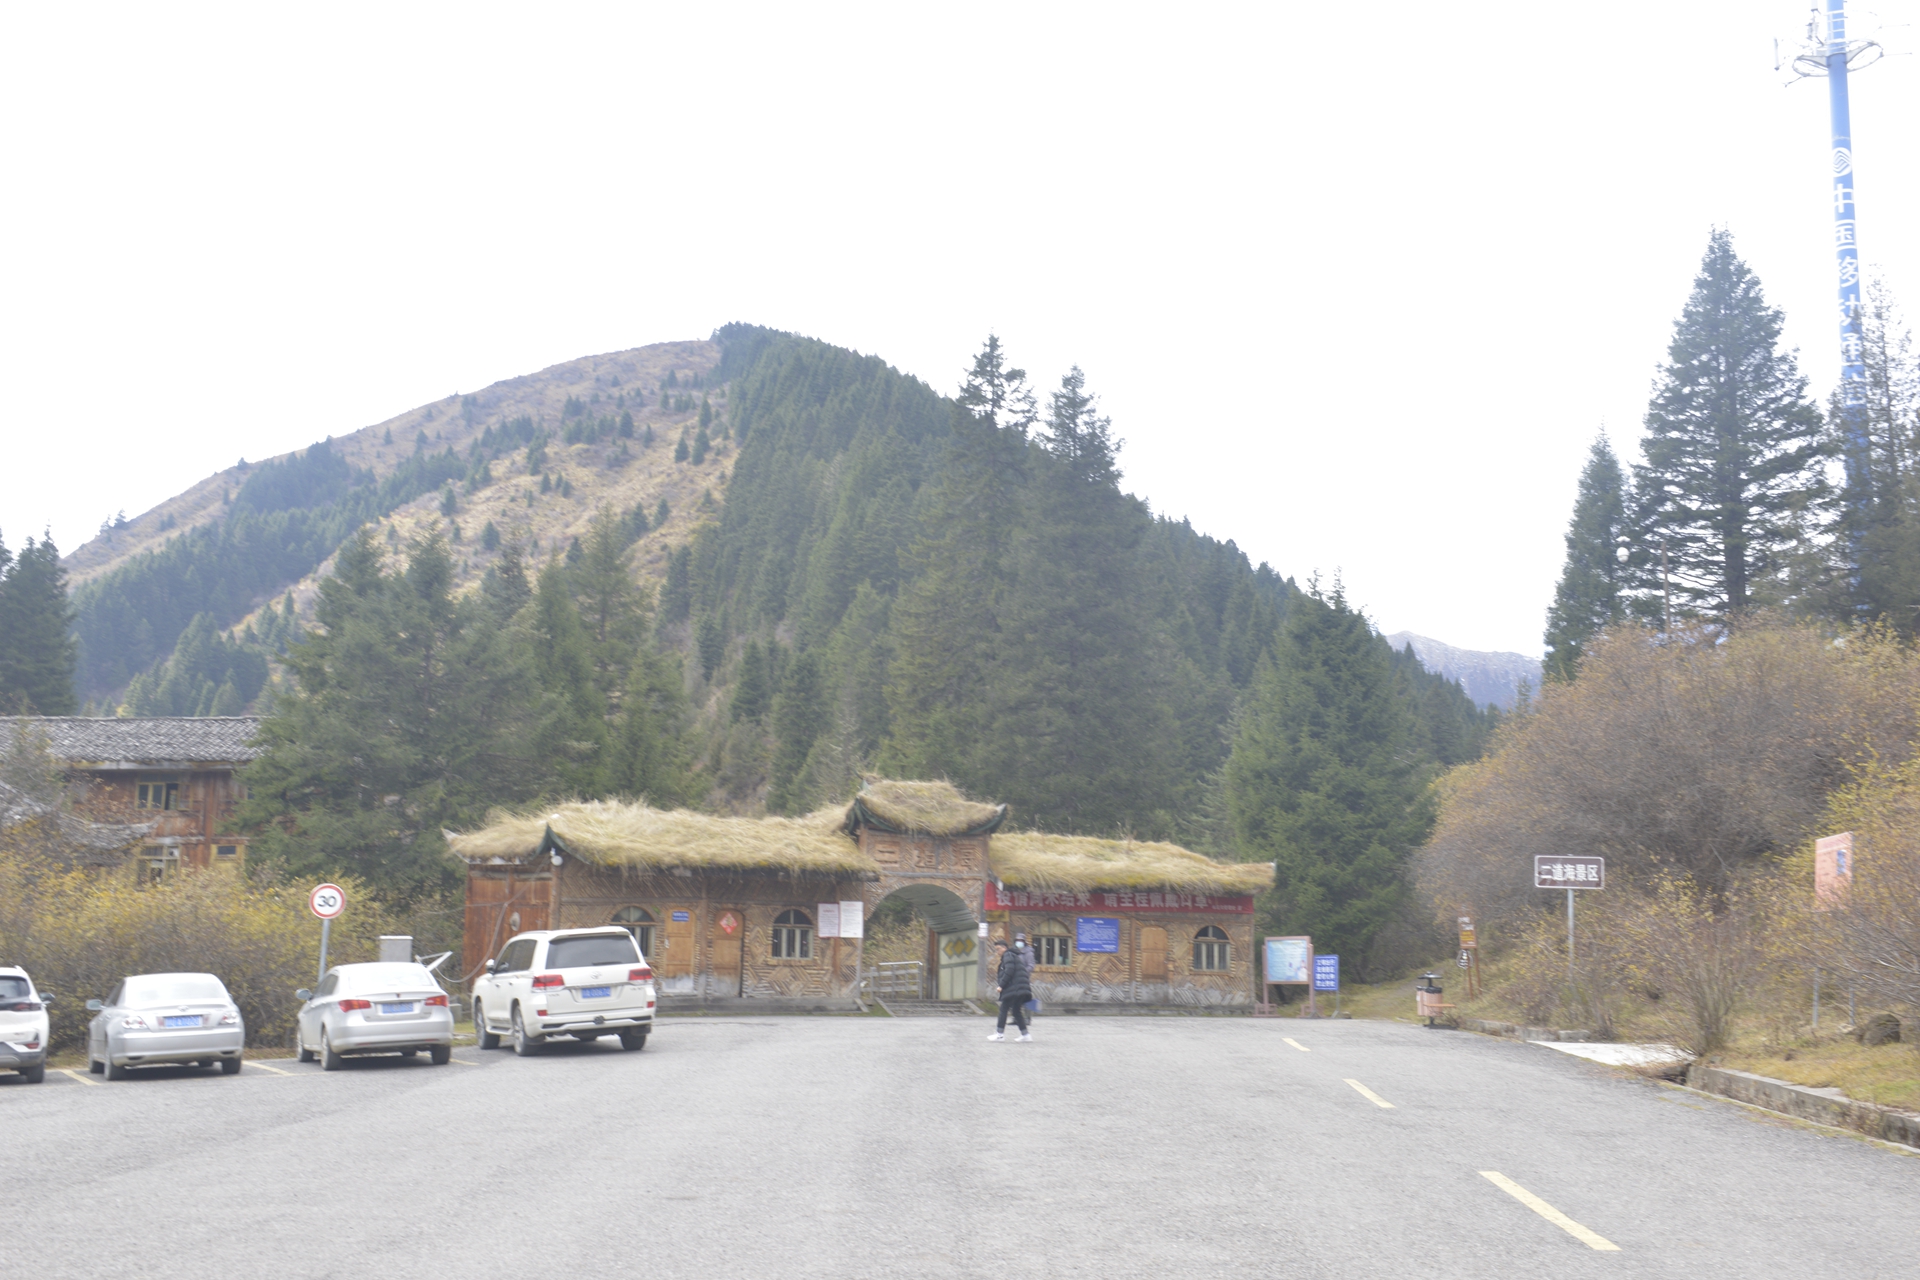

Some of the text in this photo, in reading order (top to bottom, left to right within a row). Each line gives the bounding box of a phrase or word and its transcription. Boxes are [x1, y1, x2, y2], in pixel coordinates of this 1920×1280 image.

[1540, 863, 1599, 881] 二道海景区
[317, 895, 337, 907] 30
